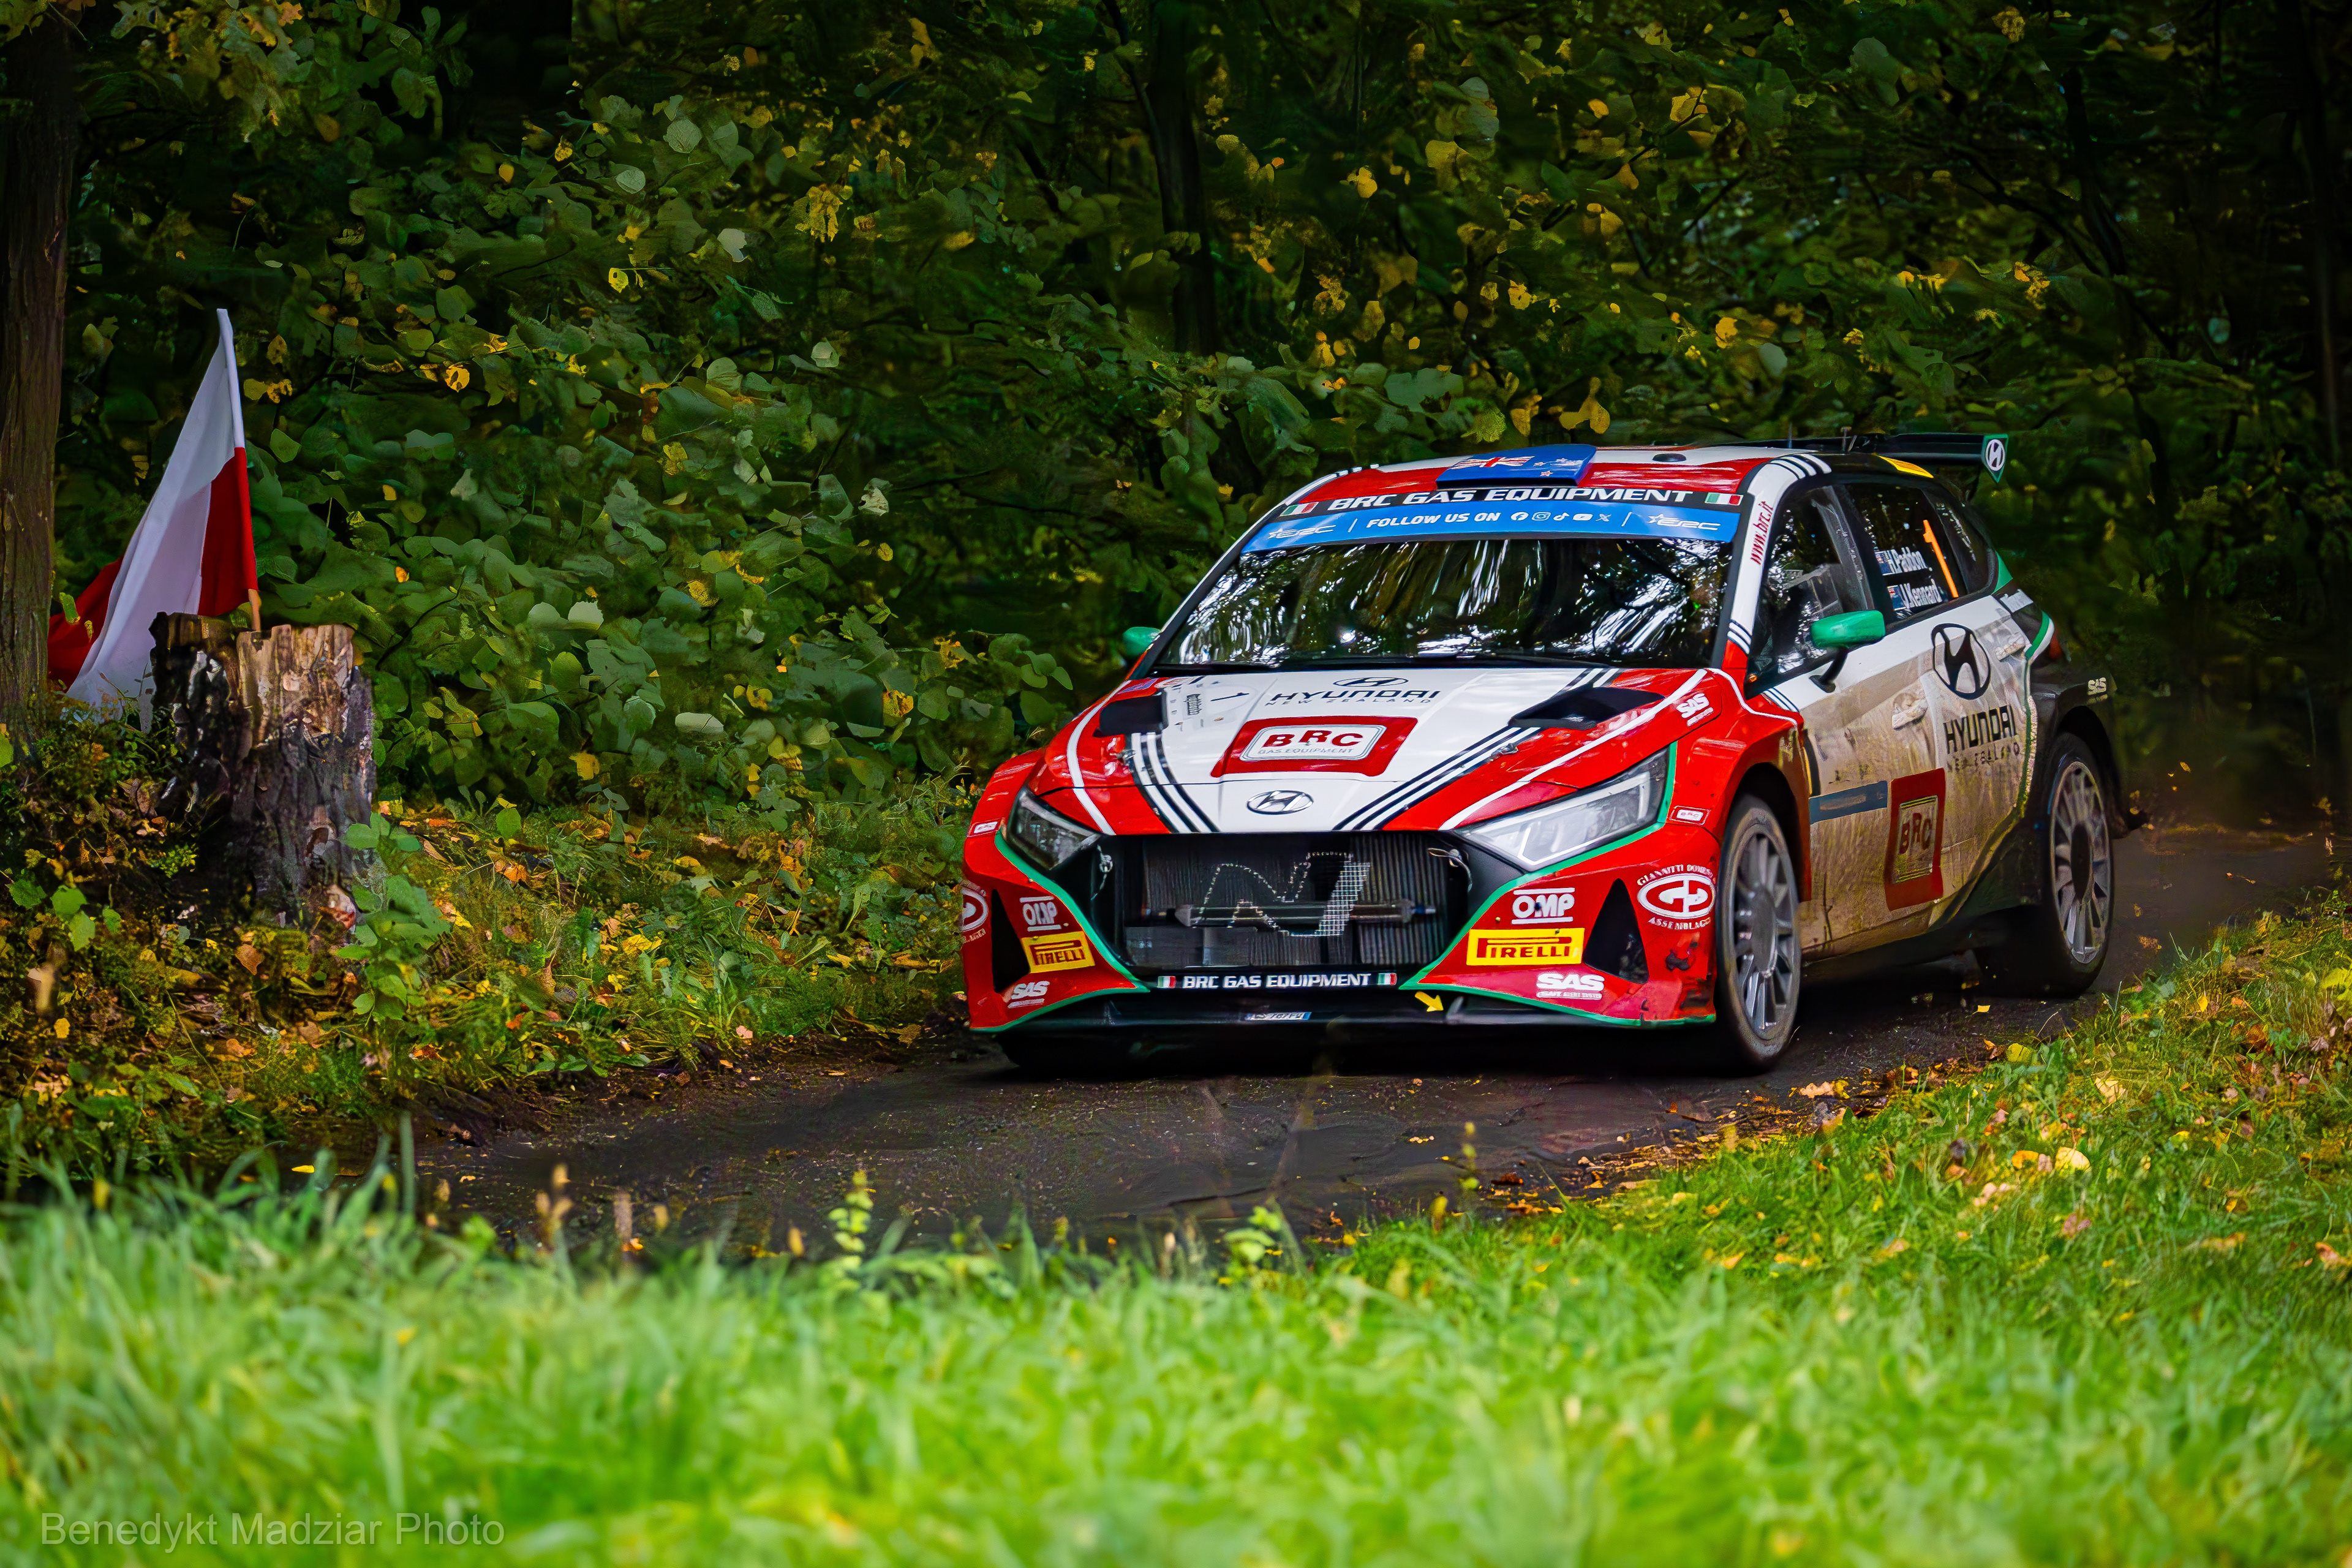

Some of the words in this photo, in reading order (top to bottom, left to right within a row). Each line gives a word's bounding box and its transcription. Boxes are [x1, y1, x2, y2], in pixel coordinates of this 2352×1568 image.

[1327, 495, 1397, 511] BRC
[1402, 490, 1476, 505] GAS
[1484, 488, 1694, 502] EQUIPMENT
[1366, 514, 1441, 529] FOLLOW
[1444, 513, 1471, 522] US
[1474, 512, 1501, 522] ON
[1751, 501, 1774, 565] www.brc.it
[1270, 690, 1441, 701] HYUNDAI
[1676, 693, 1709, 718] SAS
[1262, 730, 1363, 748] BRC
[1943, 704, 2018, 755] HYUNDAI
[1899, 812, 1932, 854] BRC
[1022, 902, 1058, 925] OMP
[1512, 893, 1575, 919] OMP
[1029, 940, 1086, 966] PIRELLI
[1477, 937, 1572, 958] PIRELLI
[1011, 981, 1050, 1000] SAS
[1182, 976, 1219, 988] BRC
[1223, 975, 1262, 988] GAS
[1265, 973, 1372, 987] EQUIPMENT
[1536, 973, 1605, 991] SAS
